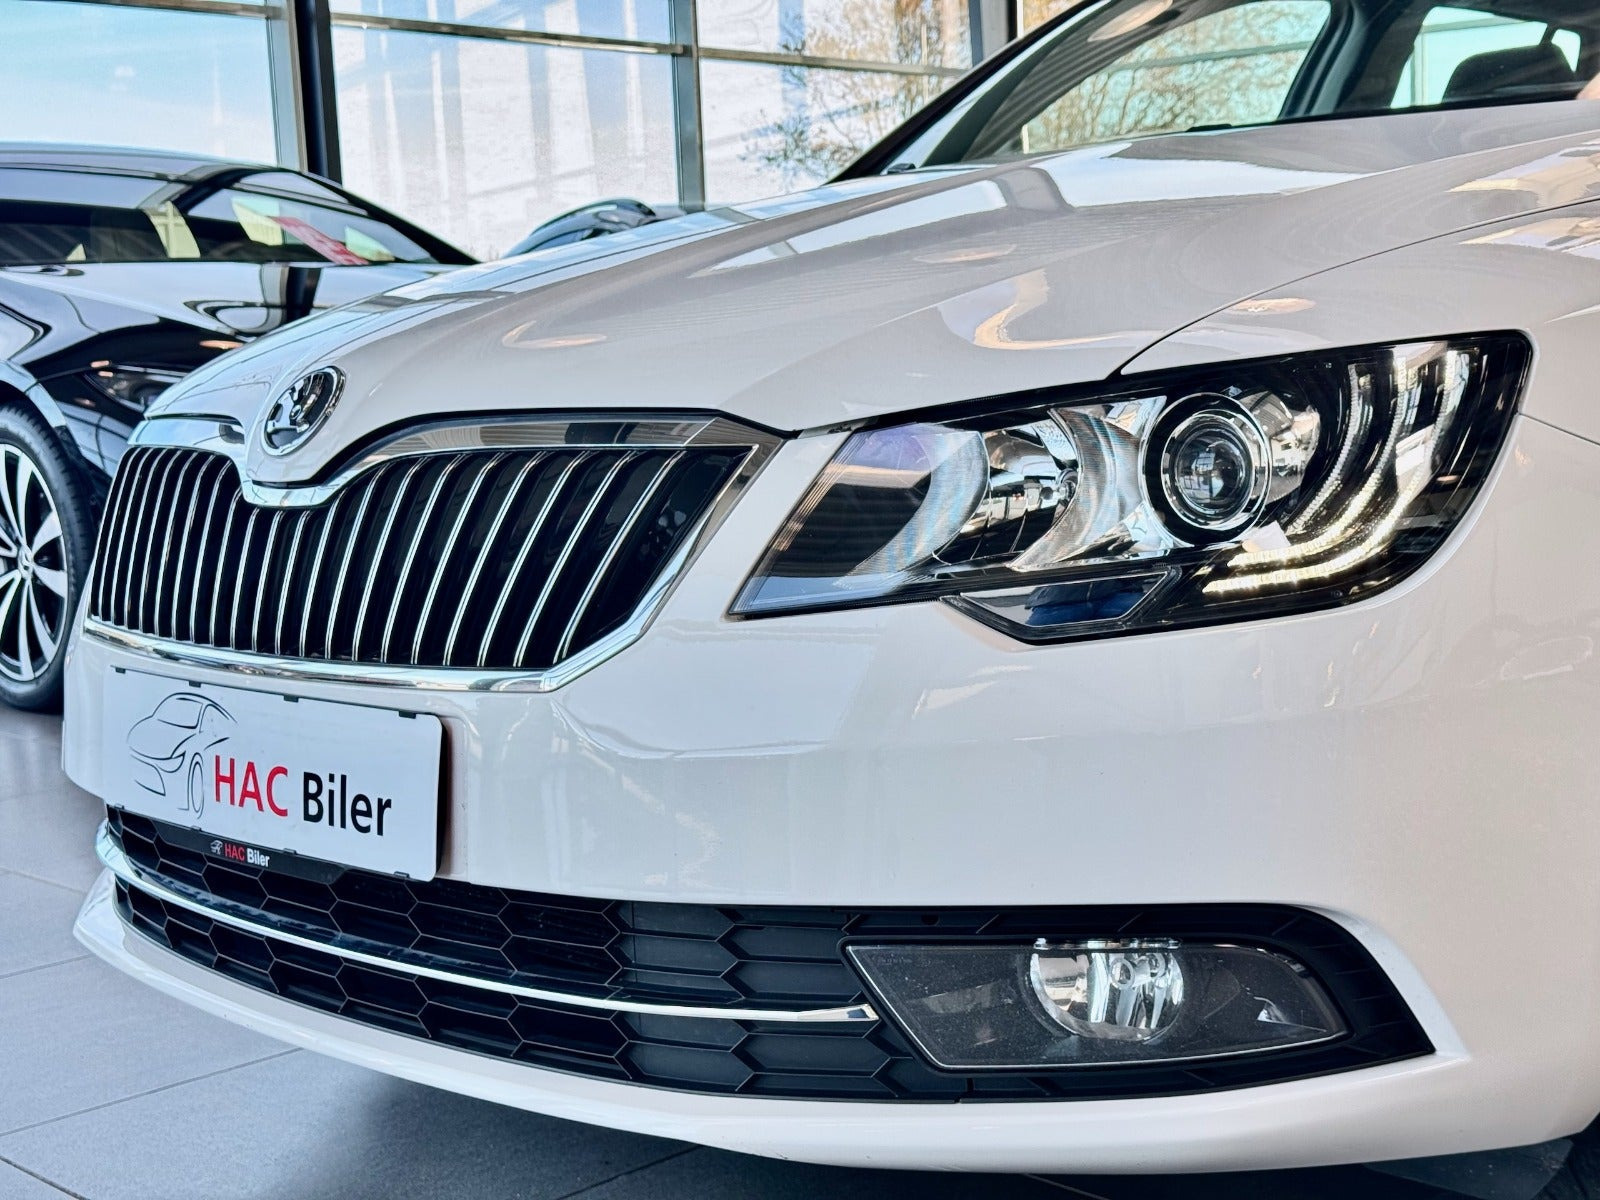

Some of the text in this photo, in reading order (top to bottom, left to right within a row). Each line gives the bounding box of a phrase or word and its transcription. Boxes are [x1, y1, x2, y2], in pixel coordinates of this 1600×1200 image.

[214, 755, 392, 837] HAC Biler
[224, 843, 270, 868] HAC Biler
